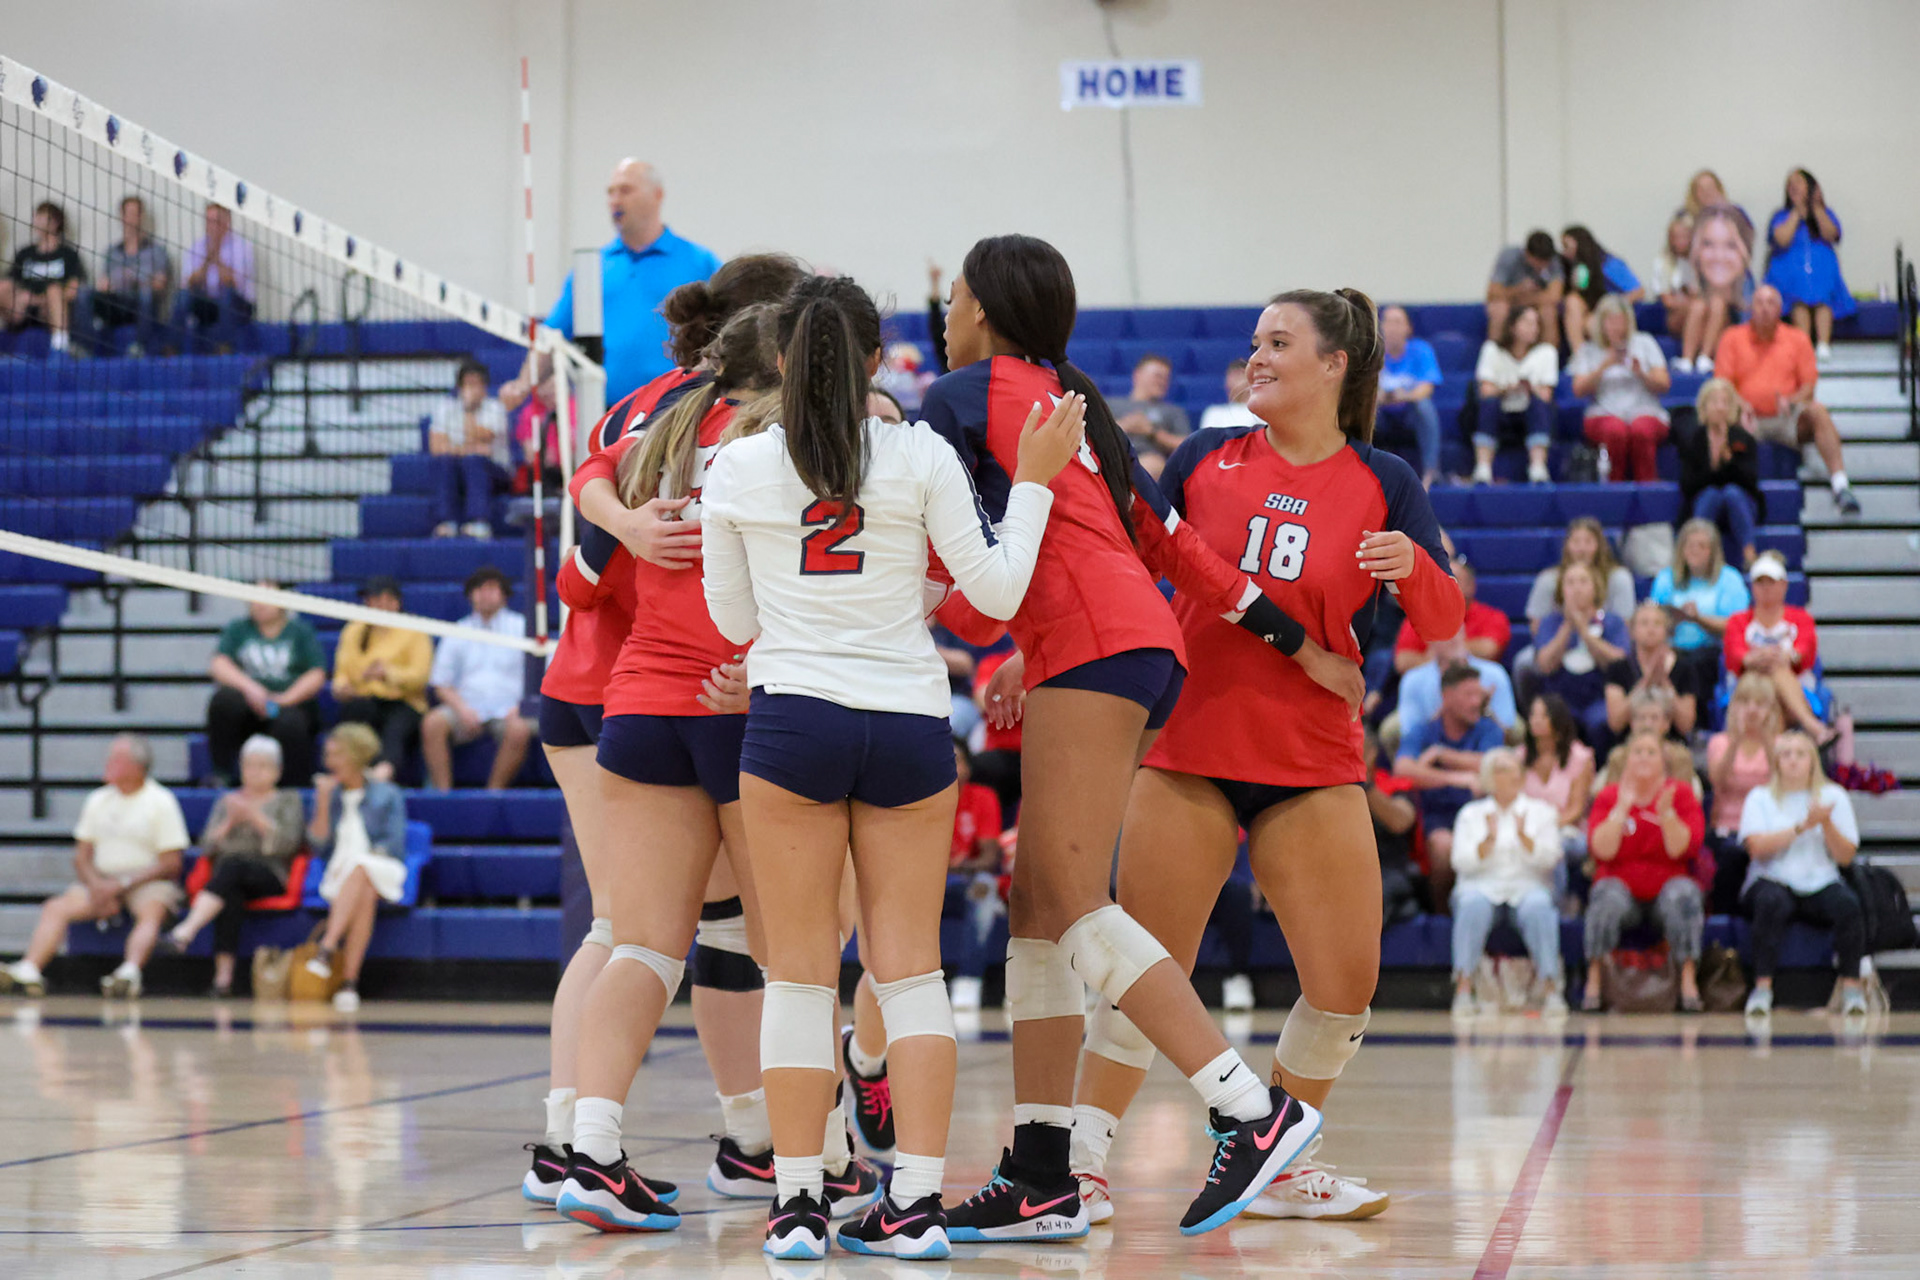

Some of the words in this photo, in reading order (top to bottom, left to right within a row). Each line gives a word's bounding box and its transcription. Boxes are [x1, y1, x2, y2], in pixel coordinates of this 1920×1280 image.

[1078, 68, 1184, 97] HOME
[1264, 492, 1309, 516] SBA
[799, 497, 865, 575] 2
[1238, 514, 1310, 582] 18
[1036, 1220, 1052, 1232] Phil
